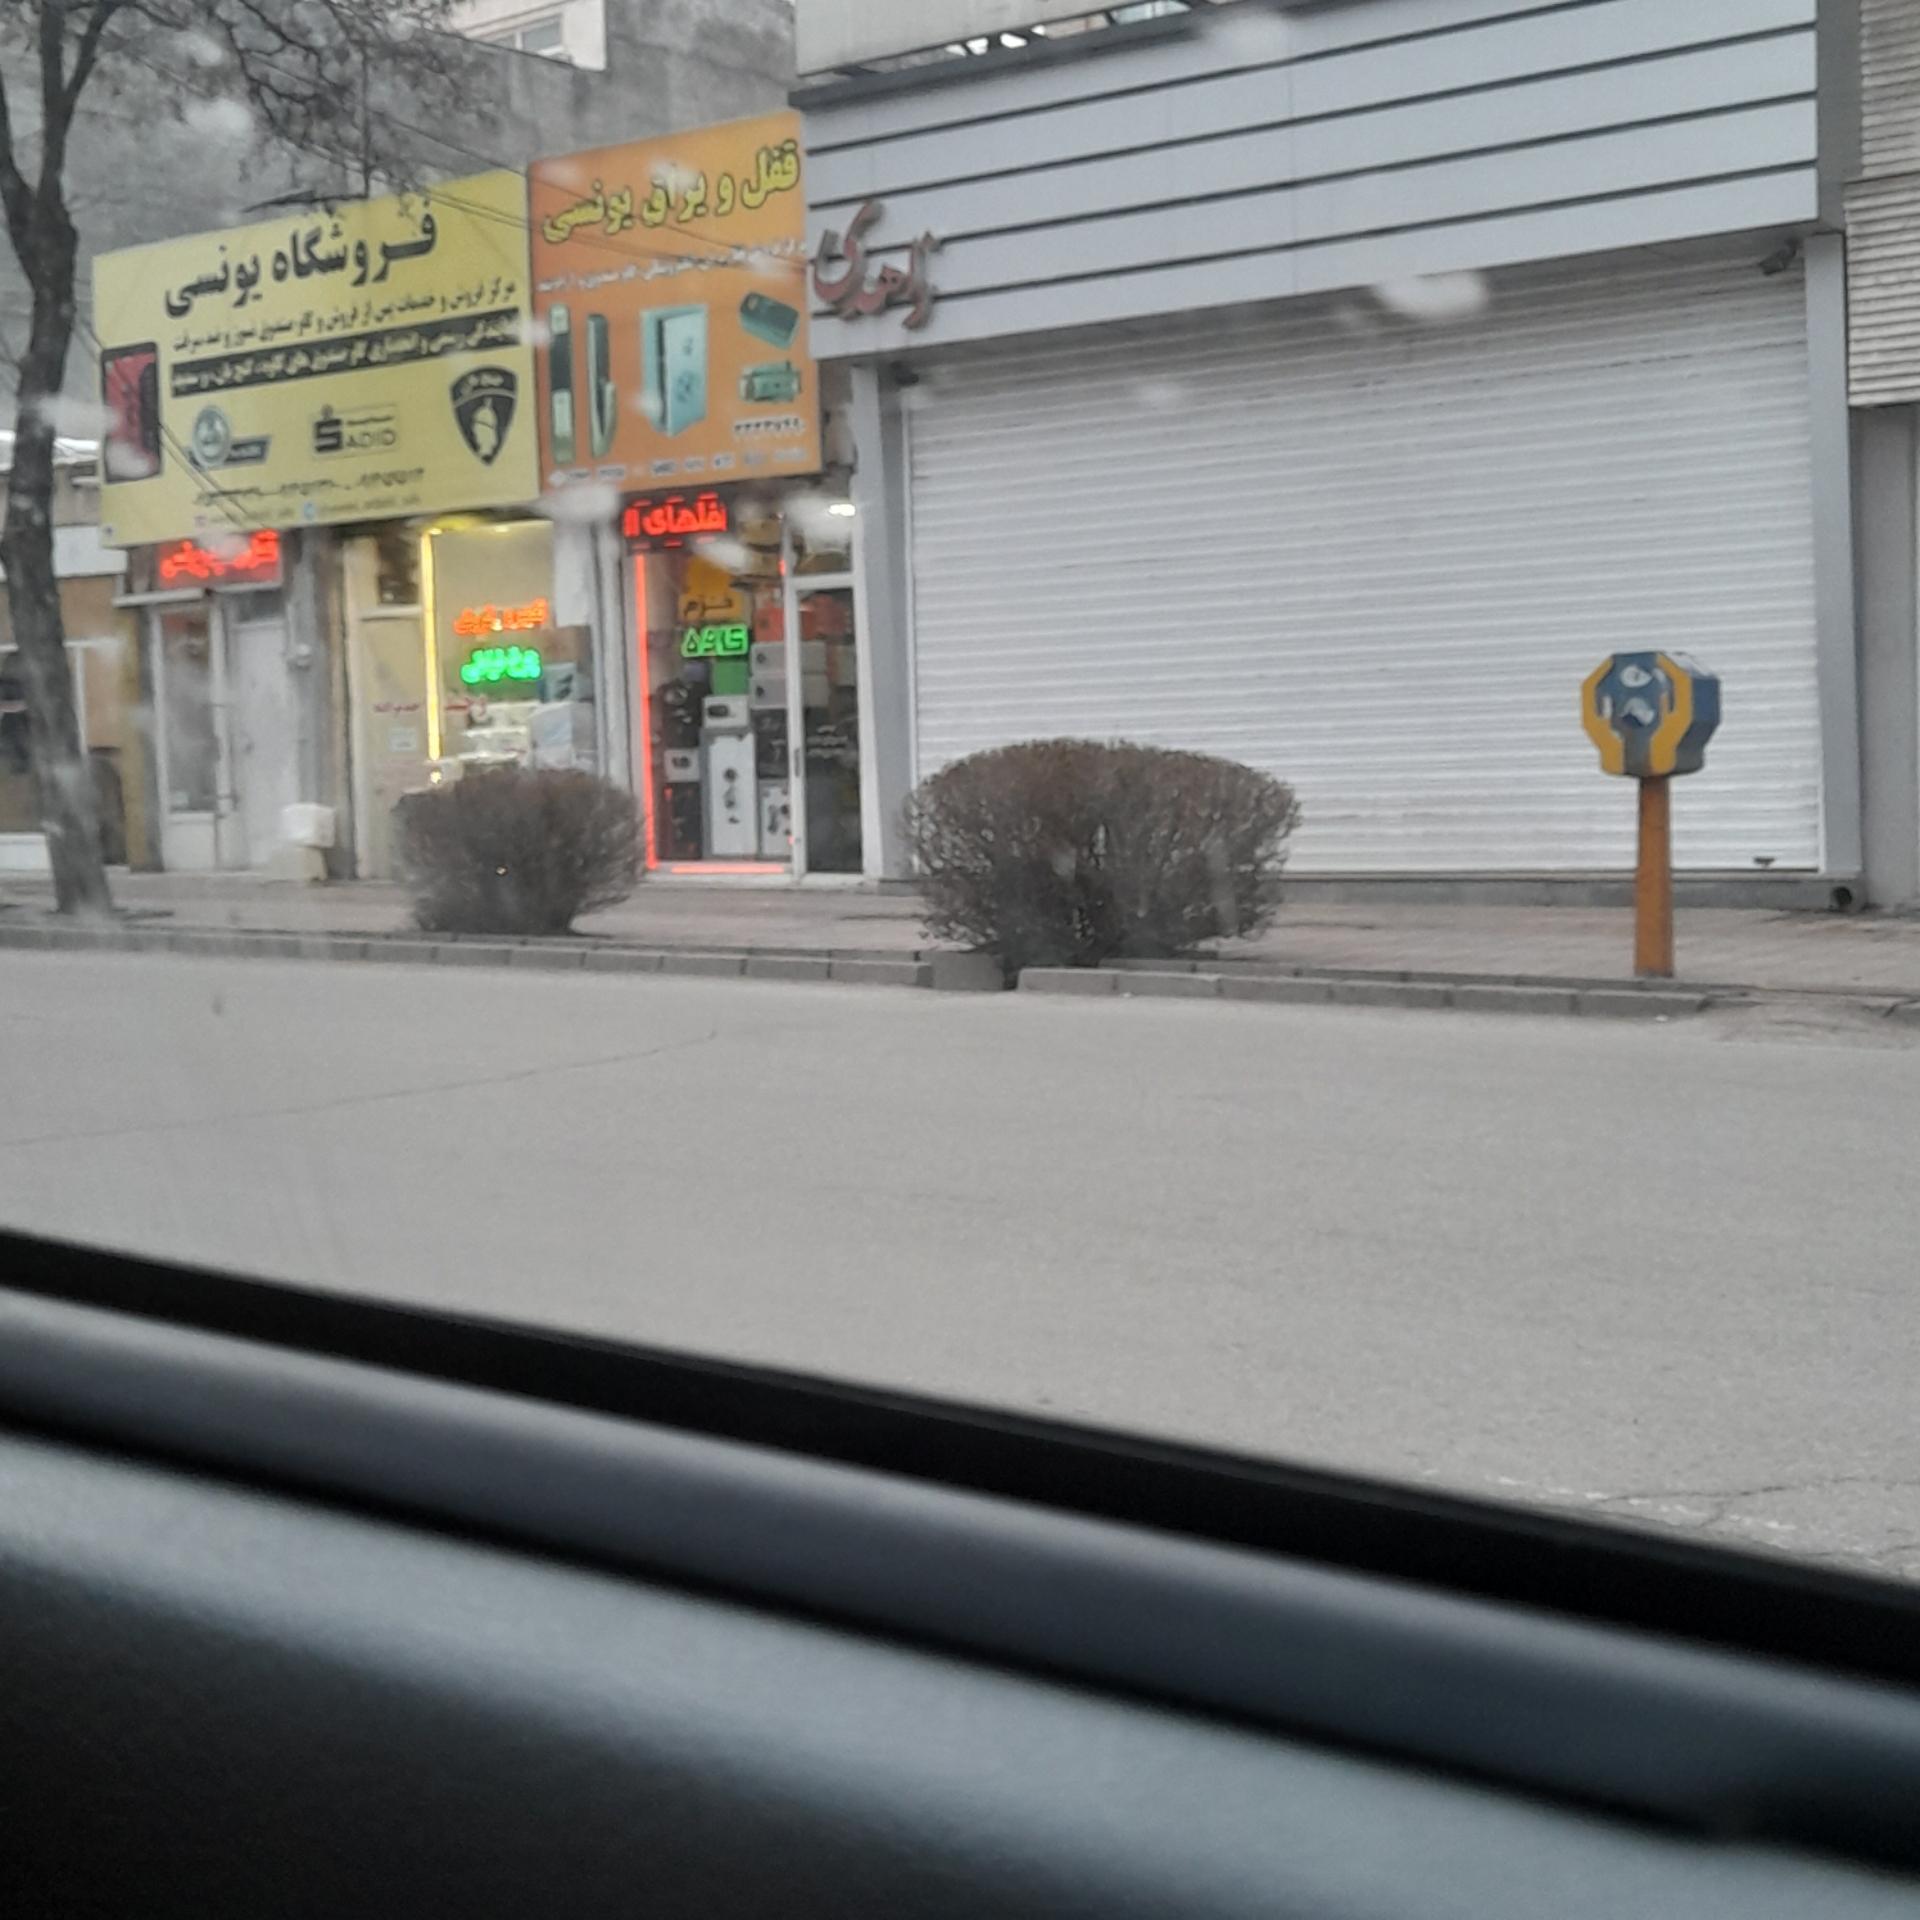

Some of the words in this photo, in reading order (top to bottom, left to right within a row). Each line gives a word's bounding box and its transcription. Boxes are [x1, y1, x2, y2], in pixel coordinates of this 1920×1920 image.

[714, 173, 736, 216] و
[742, 139, 798, 209] قفل
[272, 199, 437, 287] فروشگاه
[542, 180, 634, 243] یونسی
[165, 244, 263, 319] یونسی
